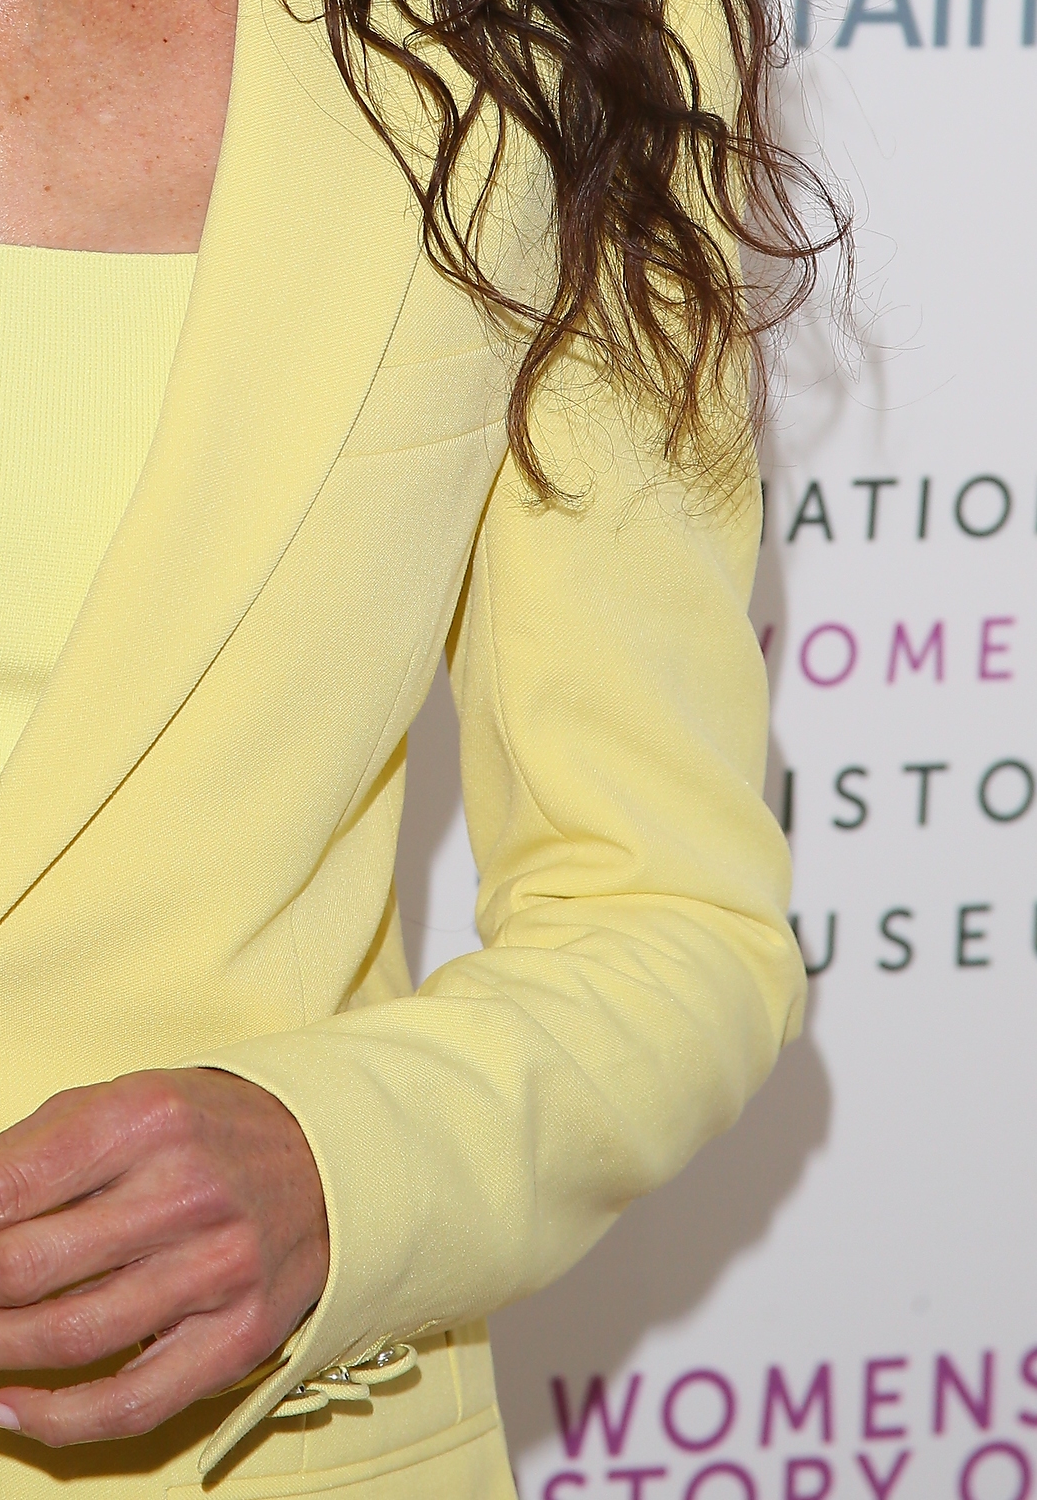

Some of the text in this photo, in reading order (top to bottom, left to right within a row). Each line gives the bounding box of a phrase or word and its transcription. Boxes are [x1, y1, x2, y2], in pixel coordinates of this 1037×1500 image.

[761, 474, 1037, 545] ATIO
[761, 616, 1014, 688] OME
[790, 903, 1037, 979] USE
